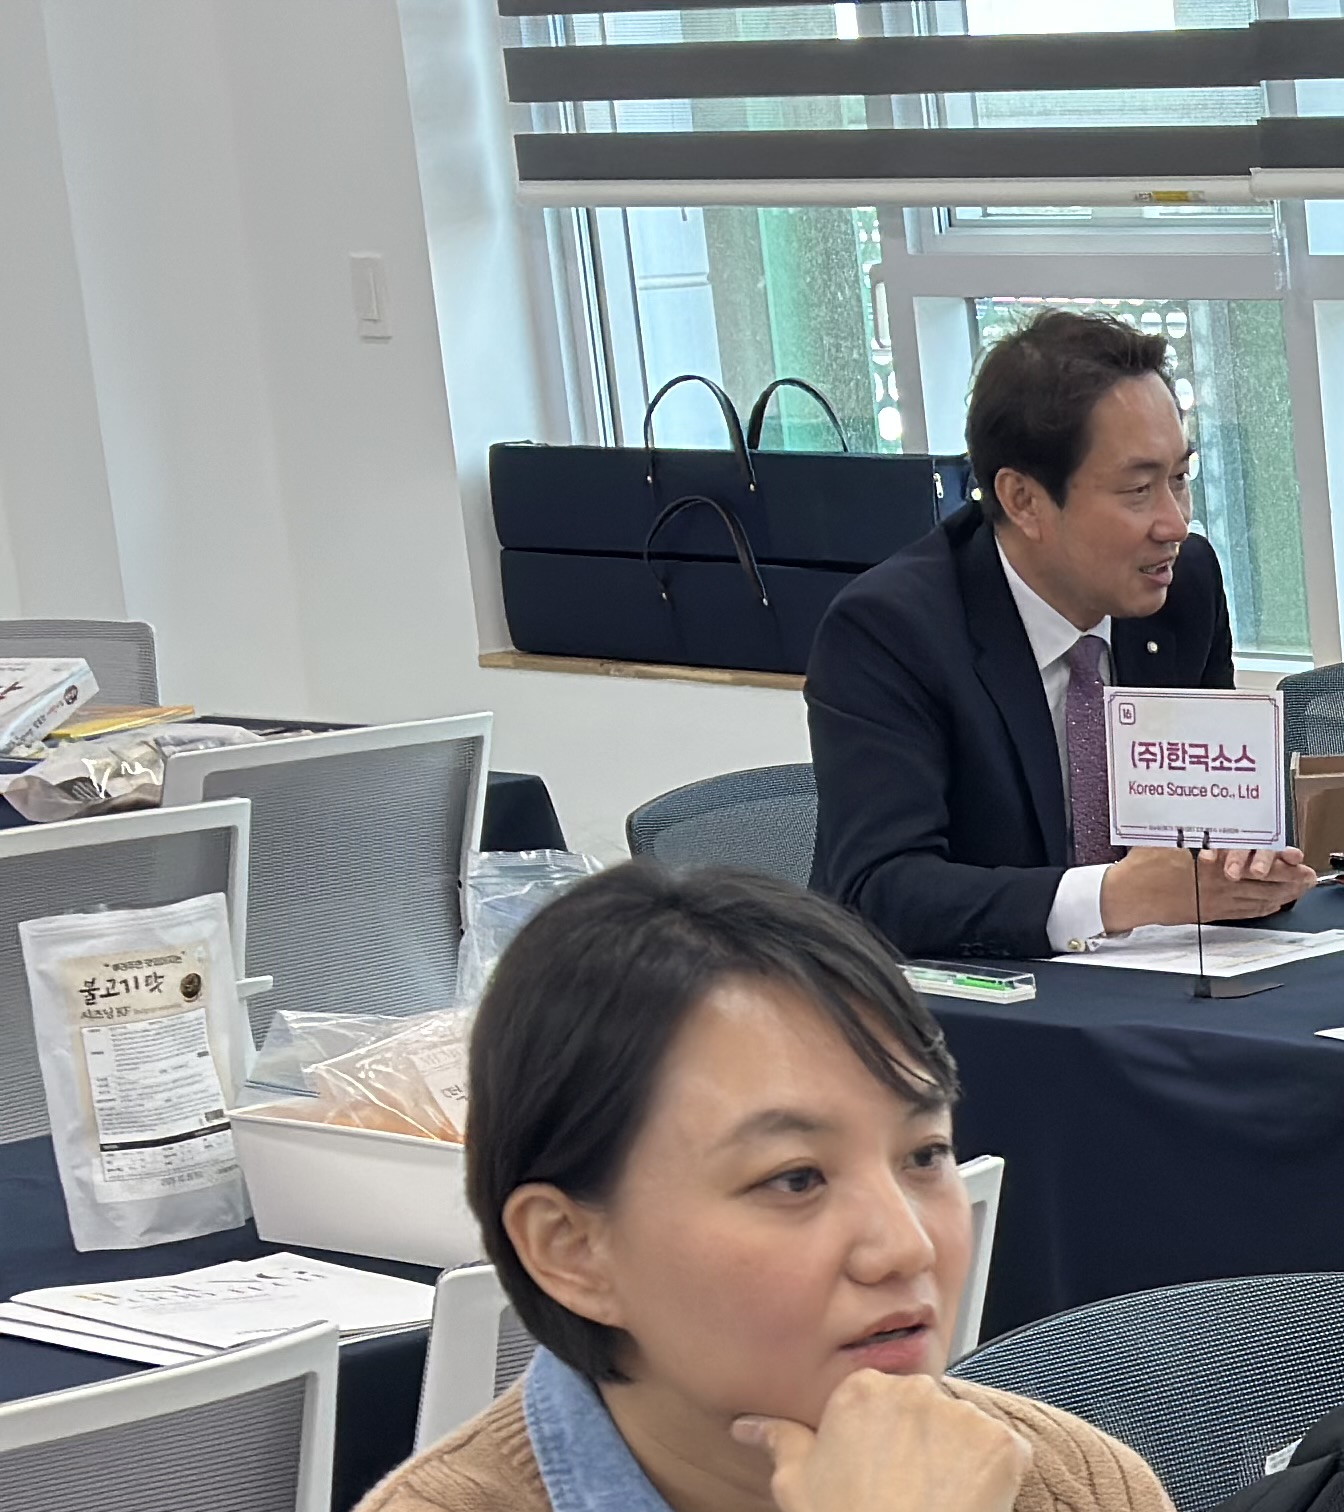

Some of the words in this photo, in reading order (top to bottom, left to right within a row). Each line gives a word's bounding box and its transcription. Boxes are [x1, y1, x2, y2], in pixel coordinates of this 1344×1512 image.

[1131, 741, 1256, 772] (주)한국소스
[1129, 781, 1164, 796] Korea
[1167, 782, 1207, 798] Sauce
[1238, 784, 1259, 799] Ltd
